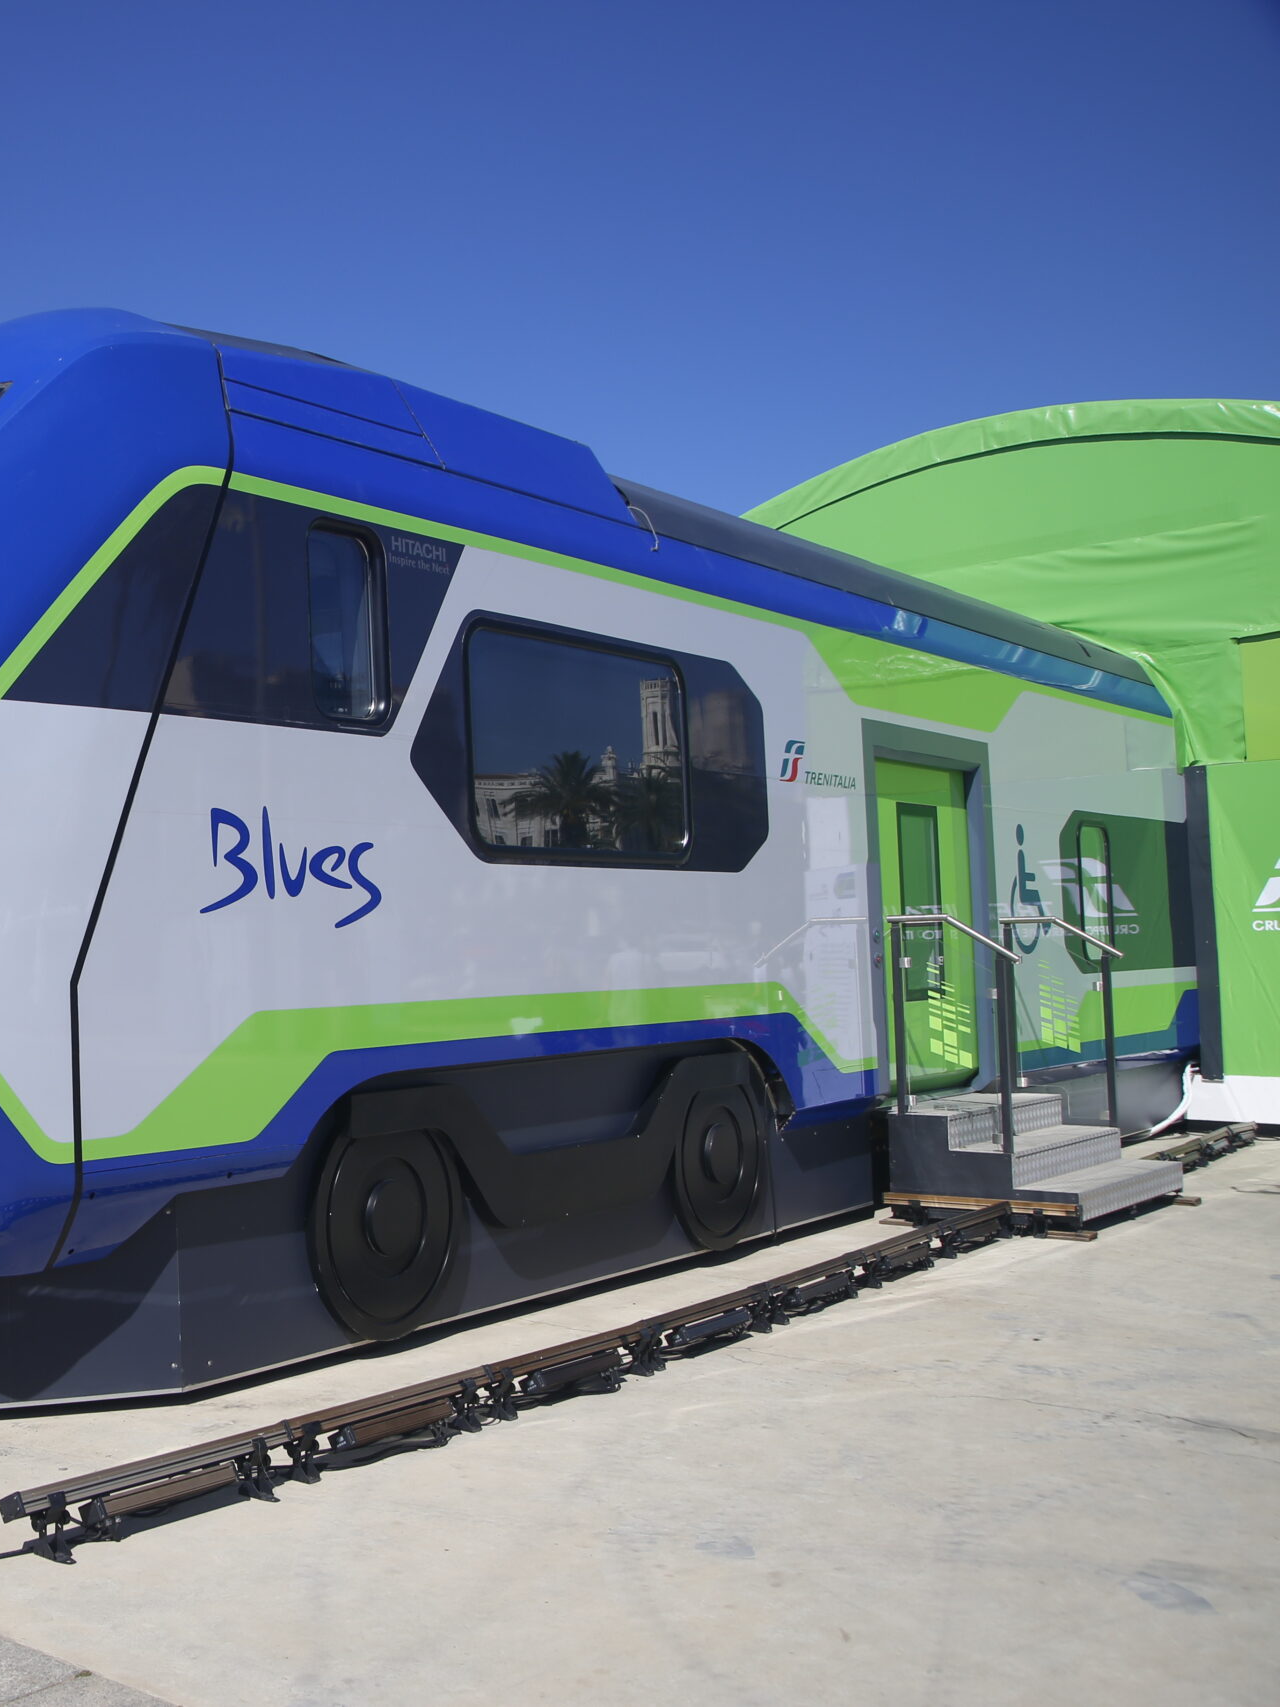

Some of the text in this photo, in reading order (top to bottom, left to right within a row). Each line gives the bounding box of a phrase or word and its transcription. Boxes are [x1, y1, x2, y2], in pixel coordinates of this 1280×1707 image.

[391, 536, 447, 562] HITACHI
[389, 552, 451, 576] Inspire the Next
[804, 771, 857, 790] TRENITALIA
[199, 805, 382, 929] Blues
